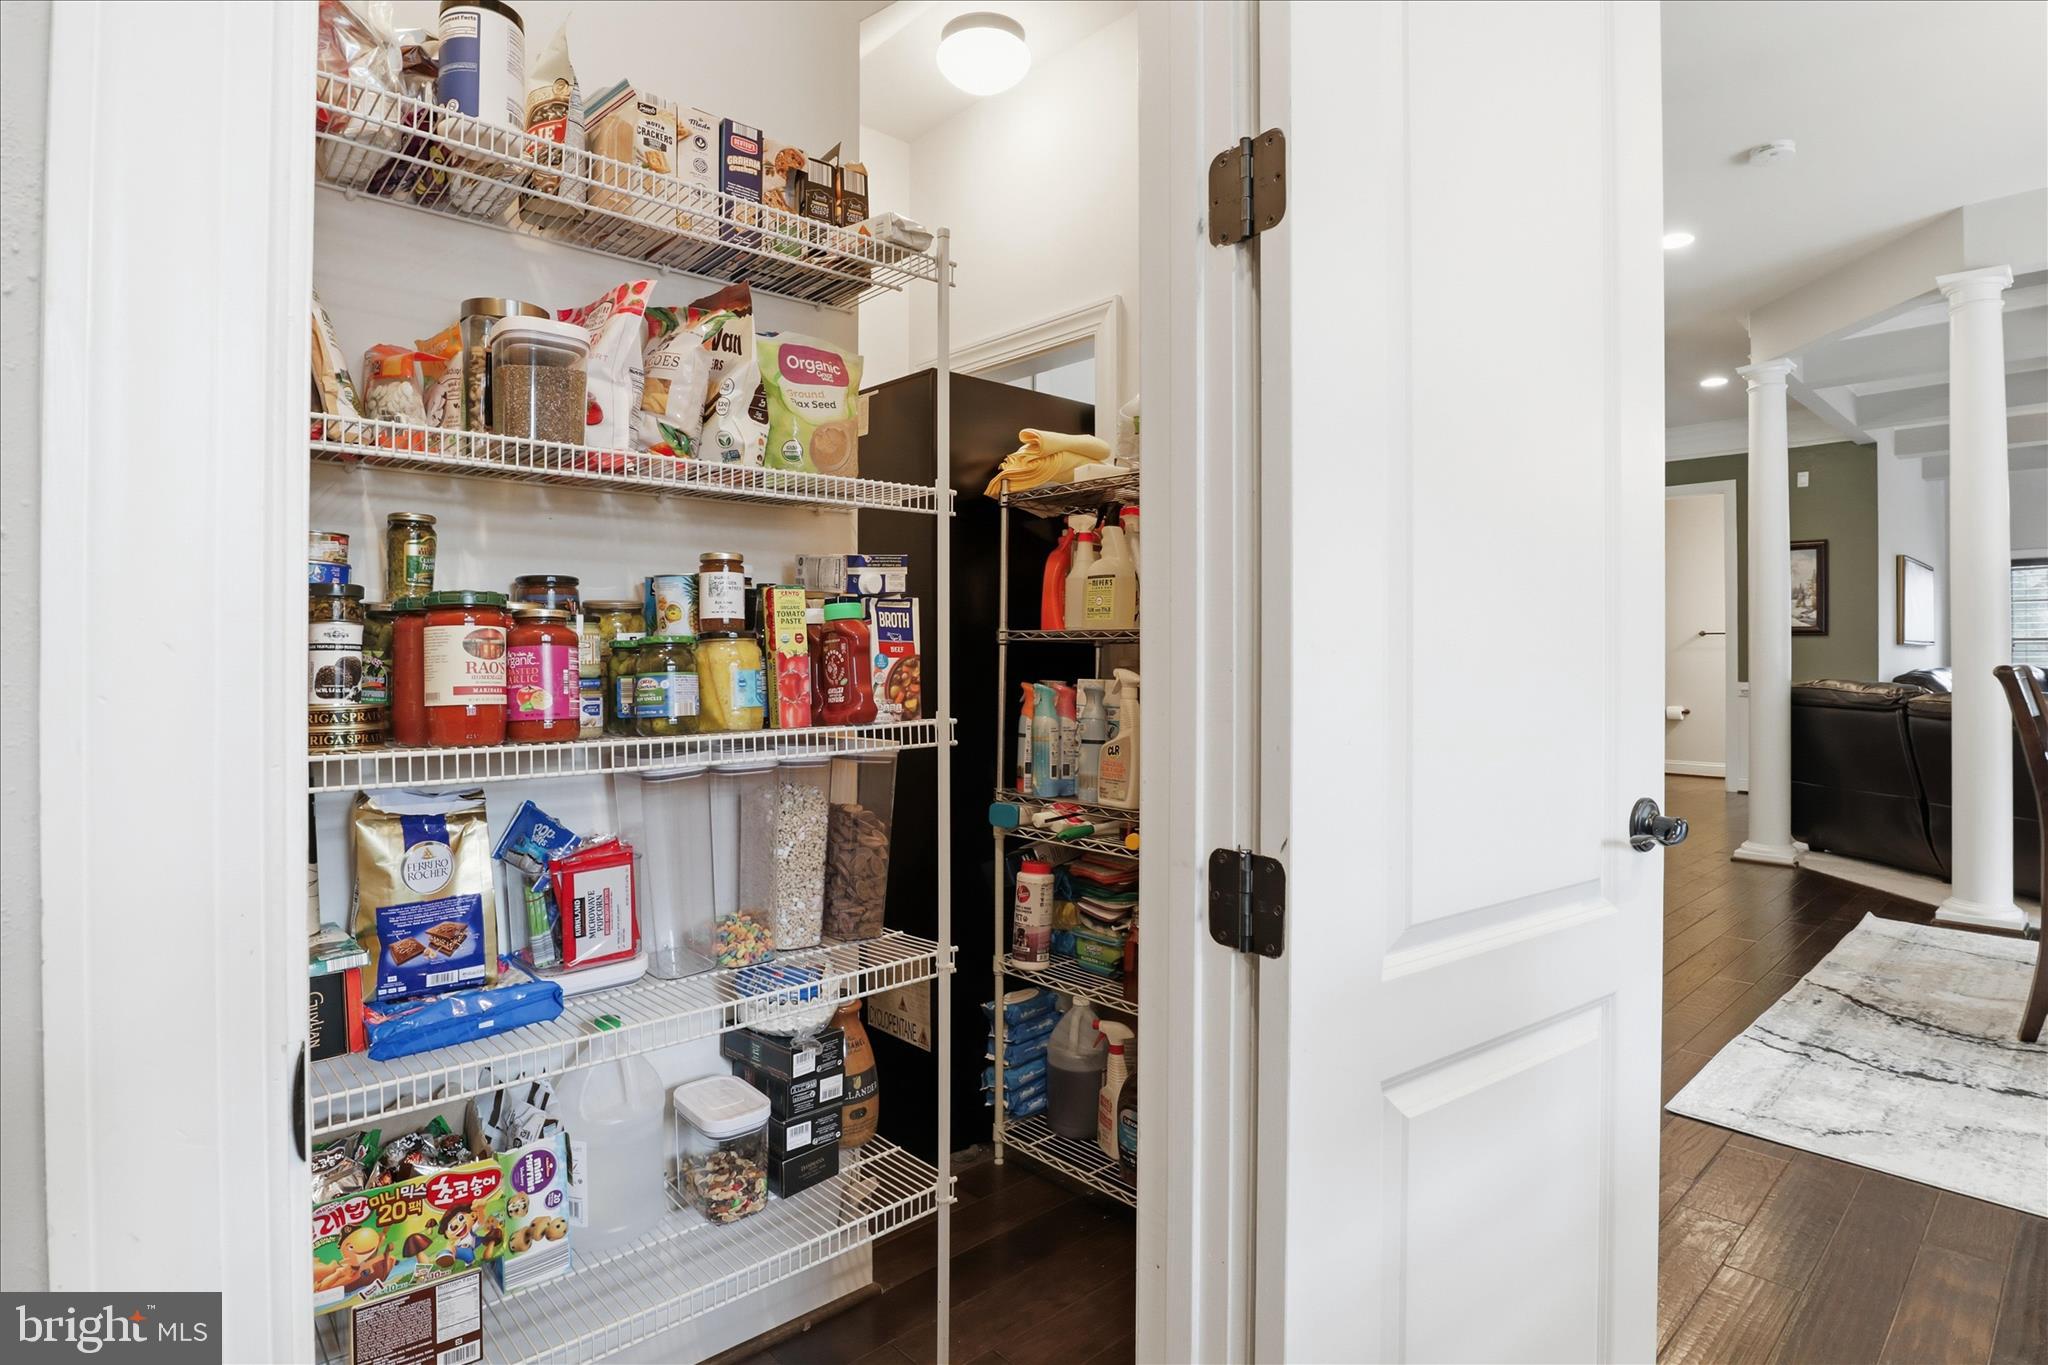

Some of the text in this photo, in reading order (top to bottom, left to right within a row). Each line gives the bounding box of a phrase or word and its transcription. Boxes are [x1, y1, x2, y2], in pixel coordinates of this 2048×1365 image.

[688, 118, 711, 131] Made
[637, 126, 673, 145] CRACKERS
[727, 155, 761, 171] GRAHAM
[786, 355, 841, 376] Organic
[791, 398, 837, 410] ax Seed
[776, 610, 806, 618] TOMATO
[879, 611, 910, 628] BROTH
[508, 655, 538, 669] rganic
[508, 667, 539, 675] ASTED
[508, 674, 539, 685] ARLIC
[308, 712, 339, 723] RIGA
[310, 733, 383, 746] RIGA SPRAT
[1107, 745, 1120, 756] CLR
[406, 858, 449, 872] FERRERO
[407, 867, 449, 882] ROCHER
[587, 890, 596, 940] MICROWAVE
[595, 894, 603, 932] POPCORN
[869, 1005, 917, 1042] CYCLOPENTANE
[368, 1182, 428, 1208] 미니믹스
[431, 1175, 497, 1206] 초코송이
[312, 1197, 369, 1236] 래밥
[377, 1201, 423, 1225] 20팩
